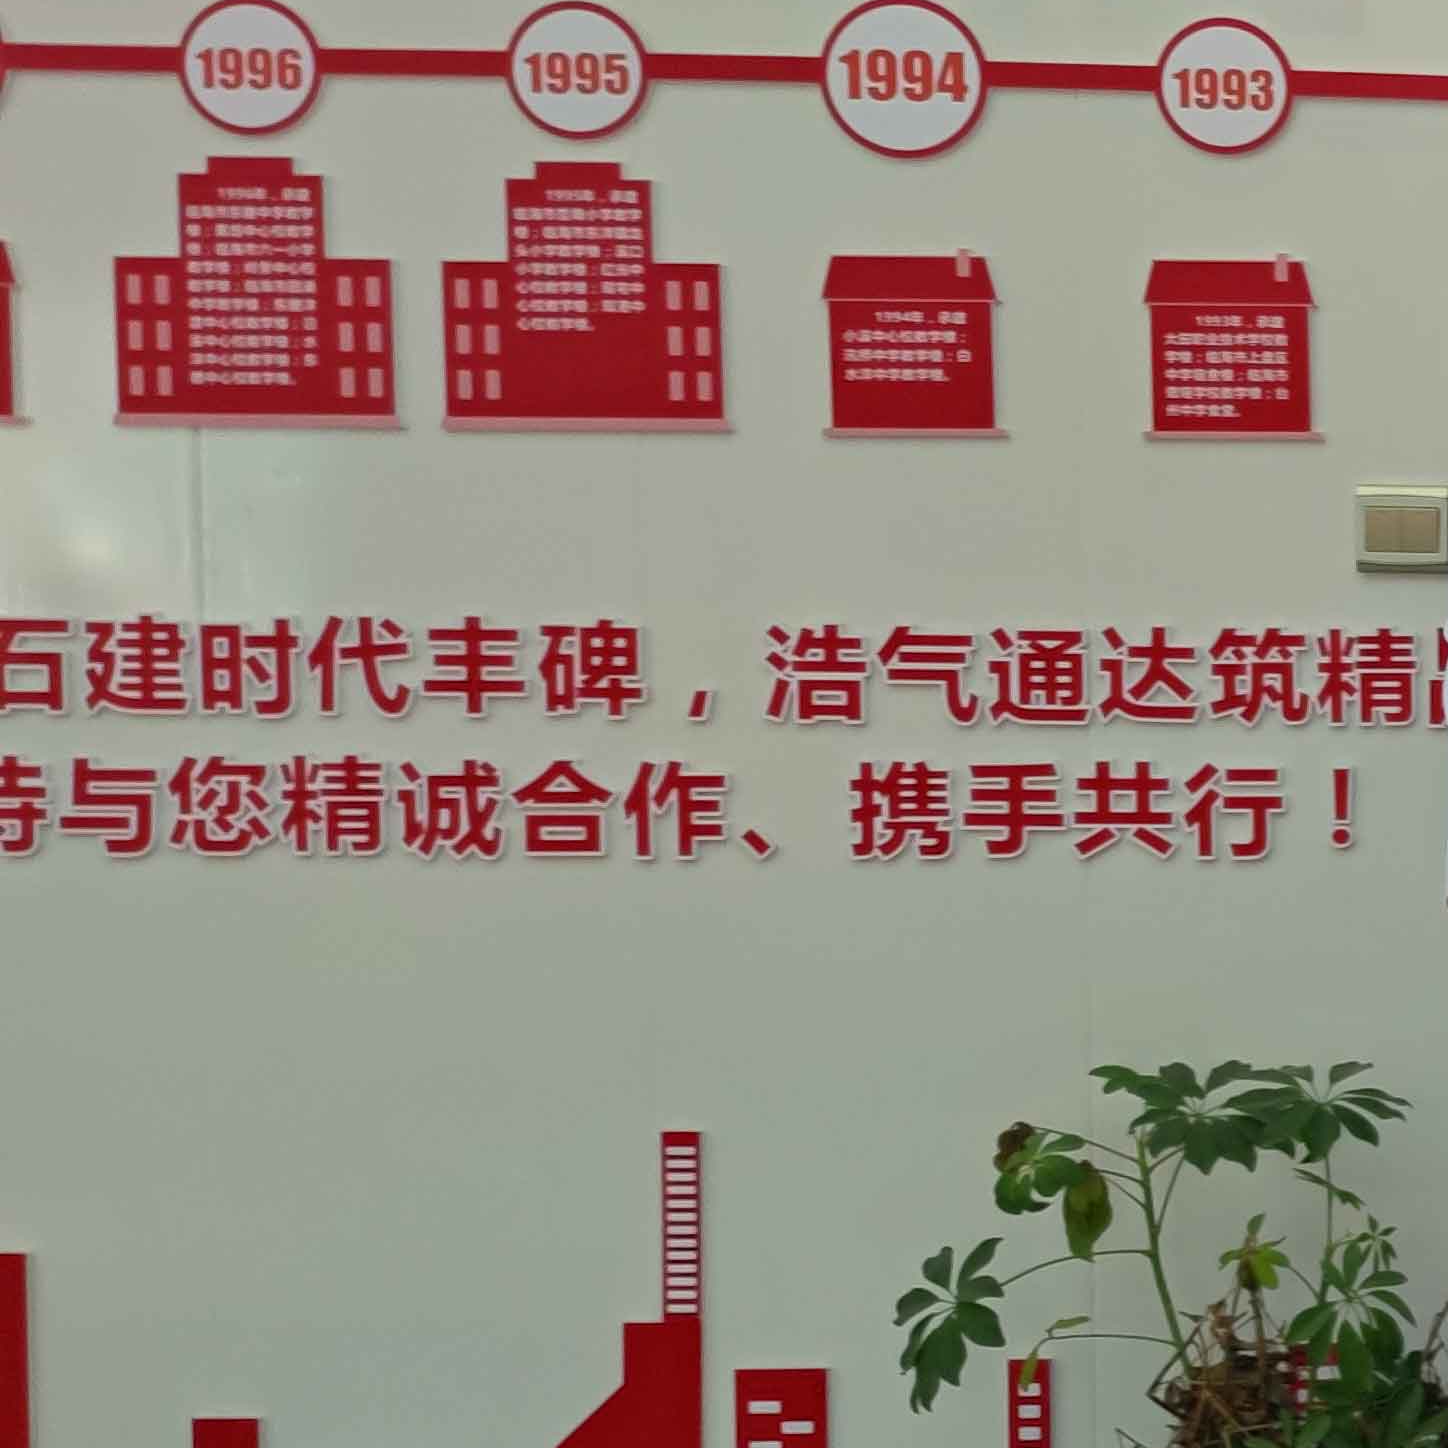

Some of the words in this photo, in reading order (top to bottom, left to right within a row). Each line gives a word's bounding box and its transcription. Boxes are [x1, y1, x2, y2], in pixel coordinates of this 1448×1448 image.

[195, 48, 303, 91] 1996
[523, 52, 631, 96] 1995
[838, 48, 969, 103] 1994
[1170, 66, 1275, 112] 1993
